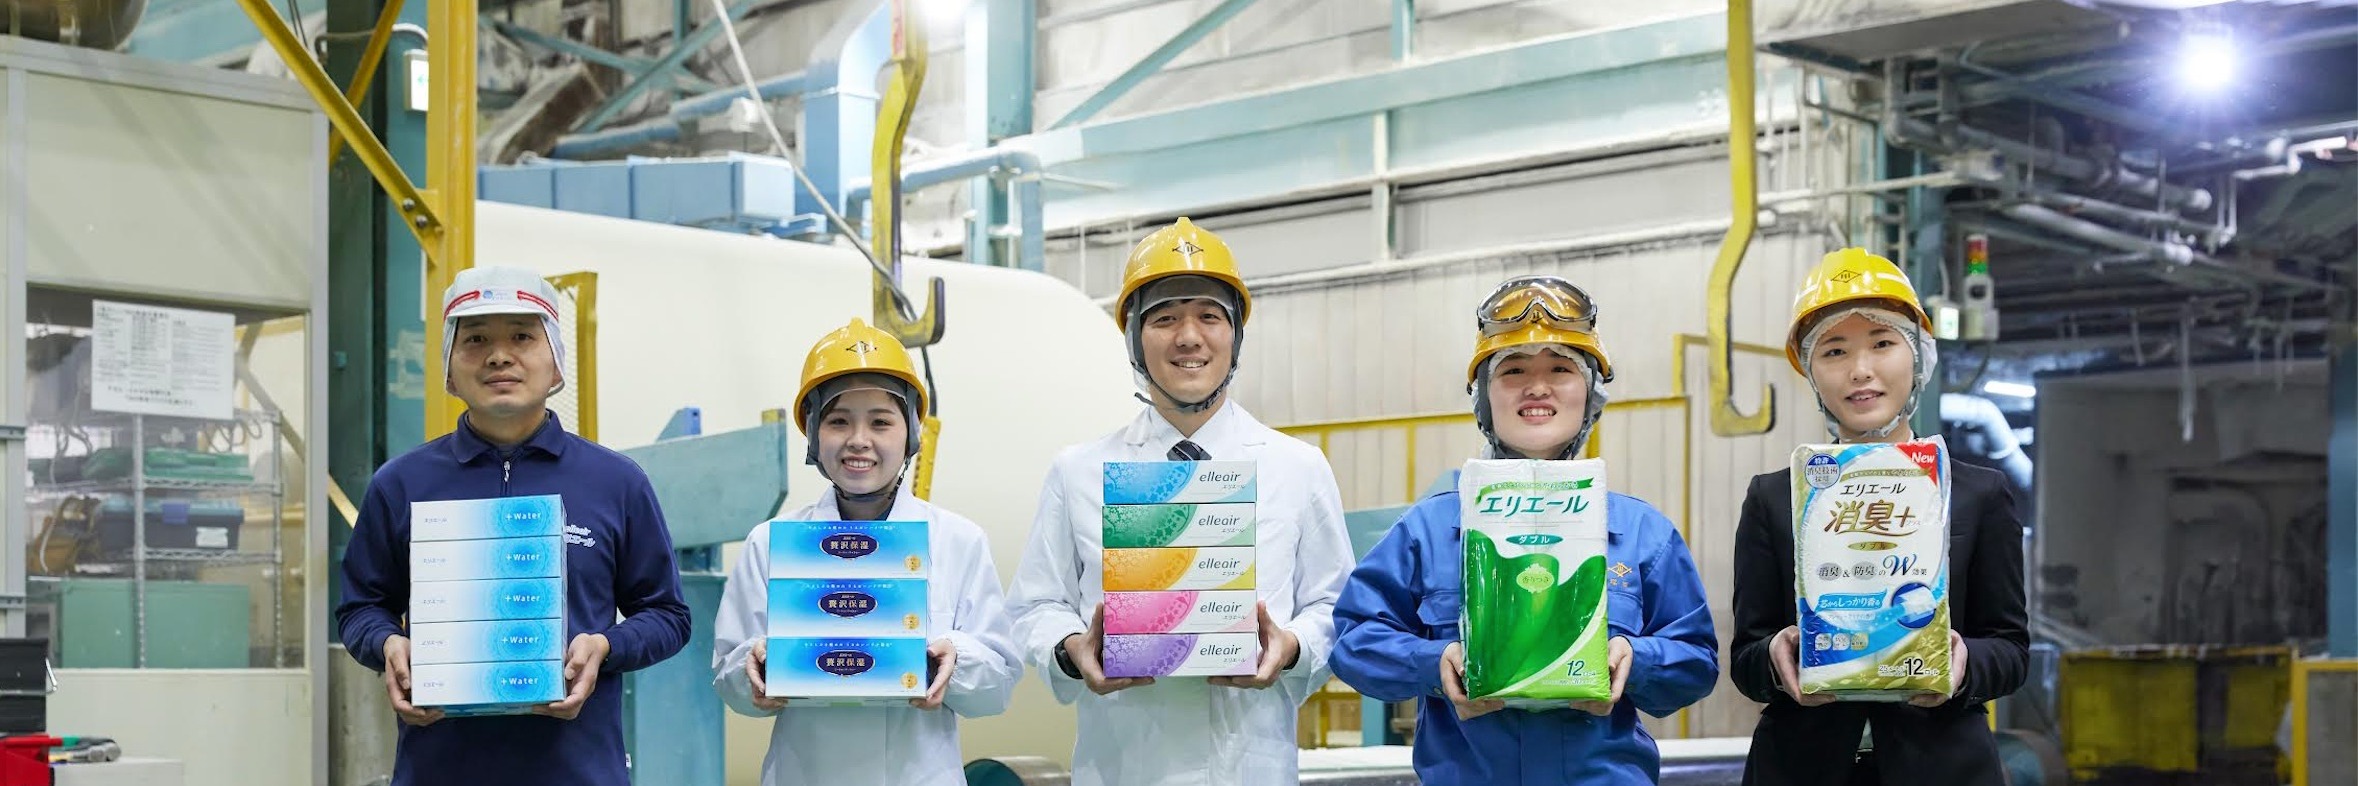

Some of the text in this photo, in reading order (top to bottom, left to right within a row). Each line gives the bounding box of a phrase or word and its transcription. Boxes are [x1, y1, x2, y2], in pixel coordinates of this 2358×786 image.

[1912, 452, 1934, 463] New
[1199, 471, 1241, 482] elleair
[1840, 483, 1906, 497] エリエール
[1480, 495, 1589, 517] エリエール
[1198, 515, 1240, 526] elleair
[1519, 535, 1550, 544] ダブル
[830, 541, 869, 550] 贅沢保湿
[1198, 558, 1240, 569] elleair
[828, 599, 868, 608] 贅沢保湿
[1200, 602, 1242, 613] elleair
[1200, 645, 1242, 656] elleair
[826, 658, 866, 667] 贅沢保湿
[1567, 661, 1584, 676] 12
